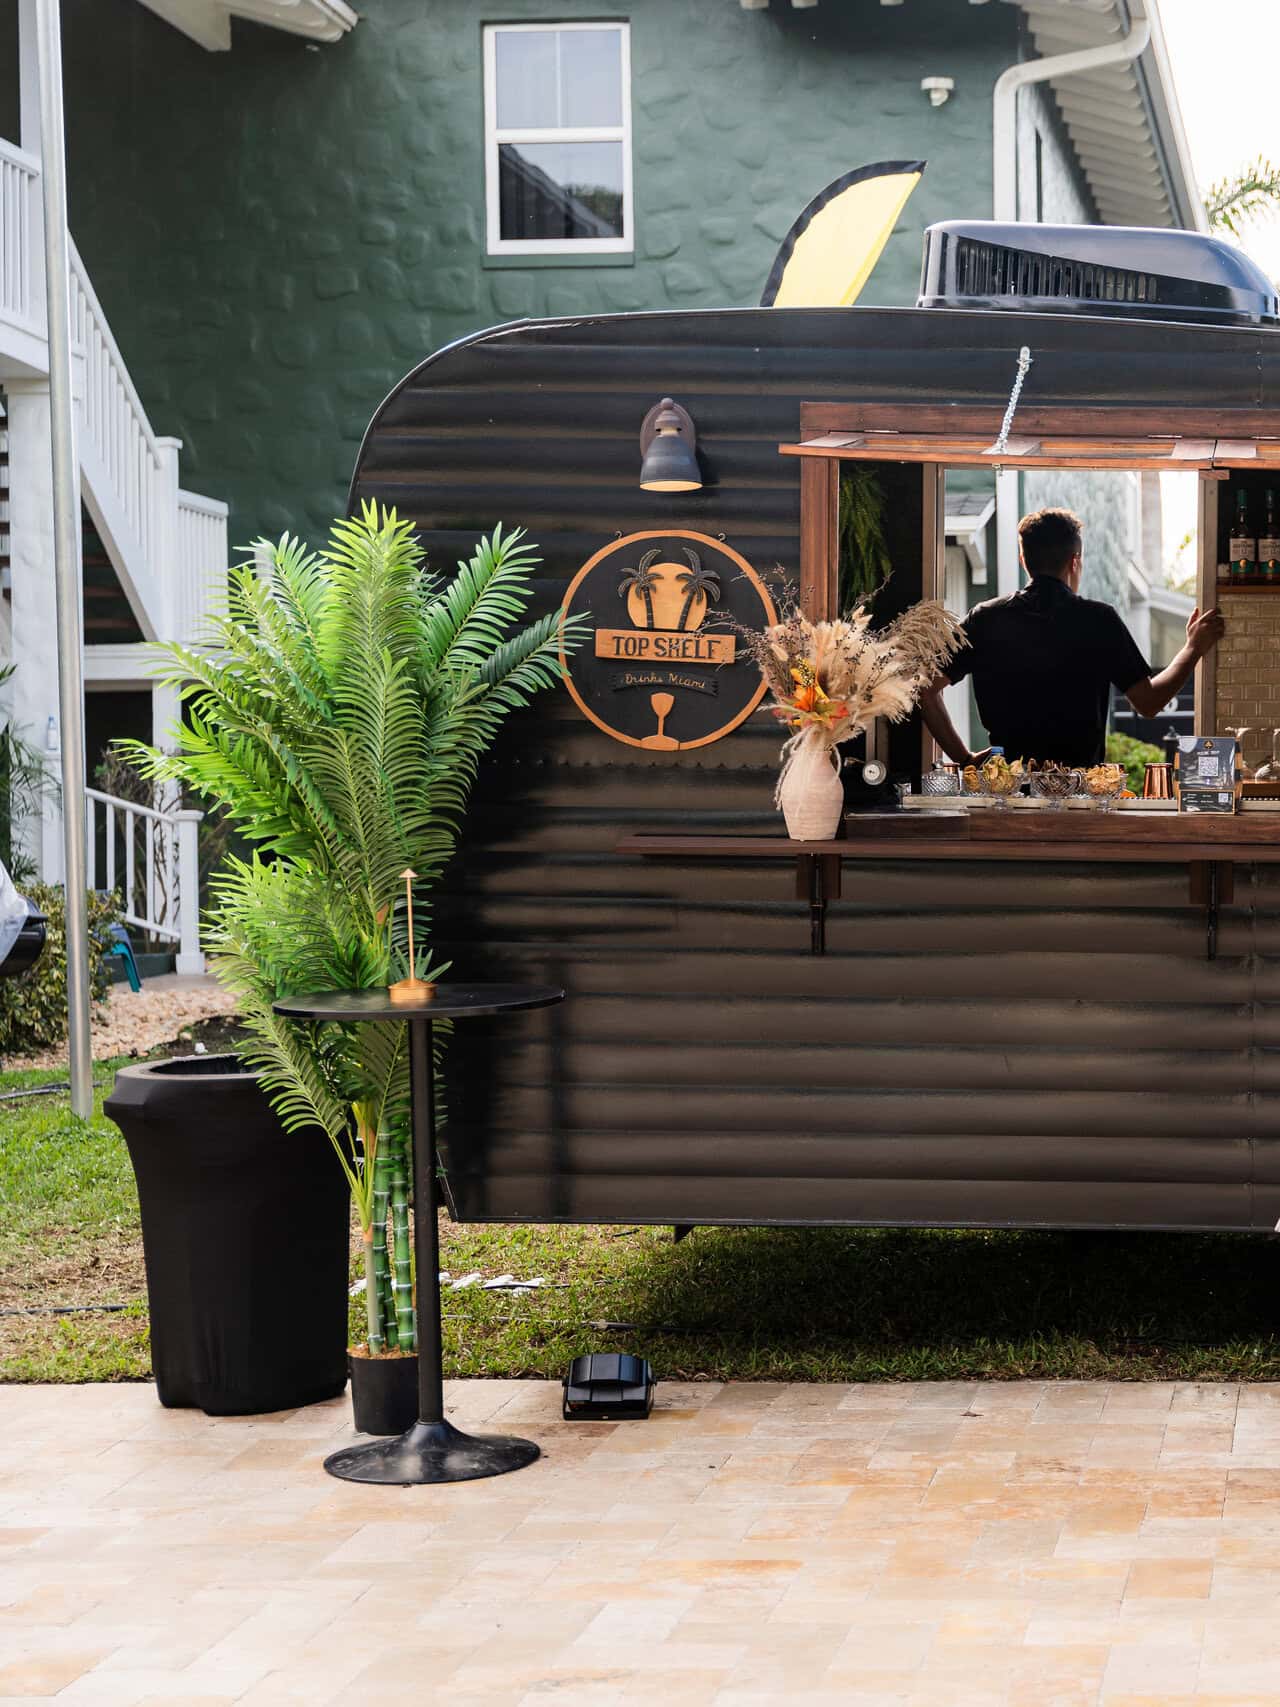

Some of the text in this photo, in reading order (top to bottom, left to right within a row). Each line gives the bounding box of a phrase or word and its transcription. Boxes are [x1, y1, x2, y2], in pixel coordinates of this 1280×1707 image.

[612, 636, 721, 659] TOP SHELF
[625, 672, 706, 689] Drinks Miami
